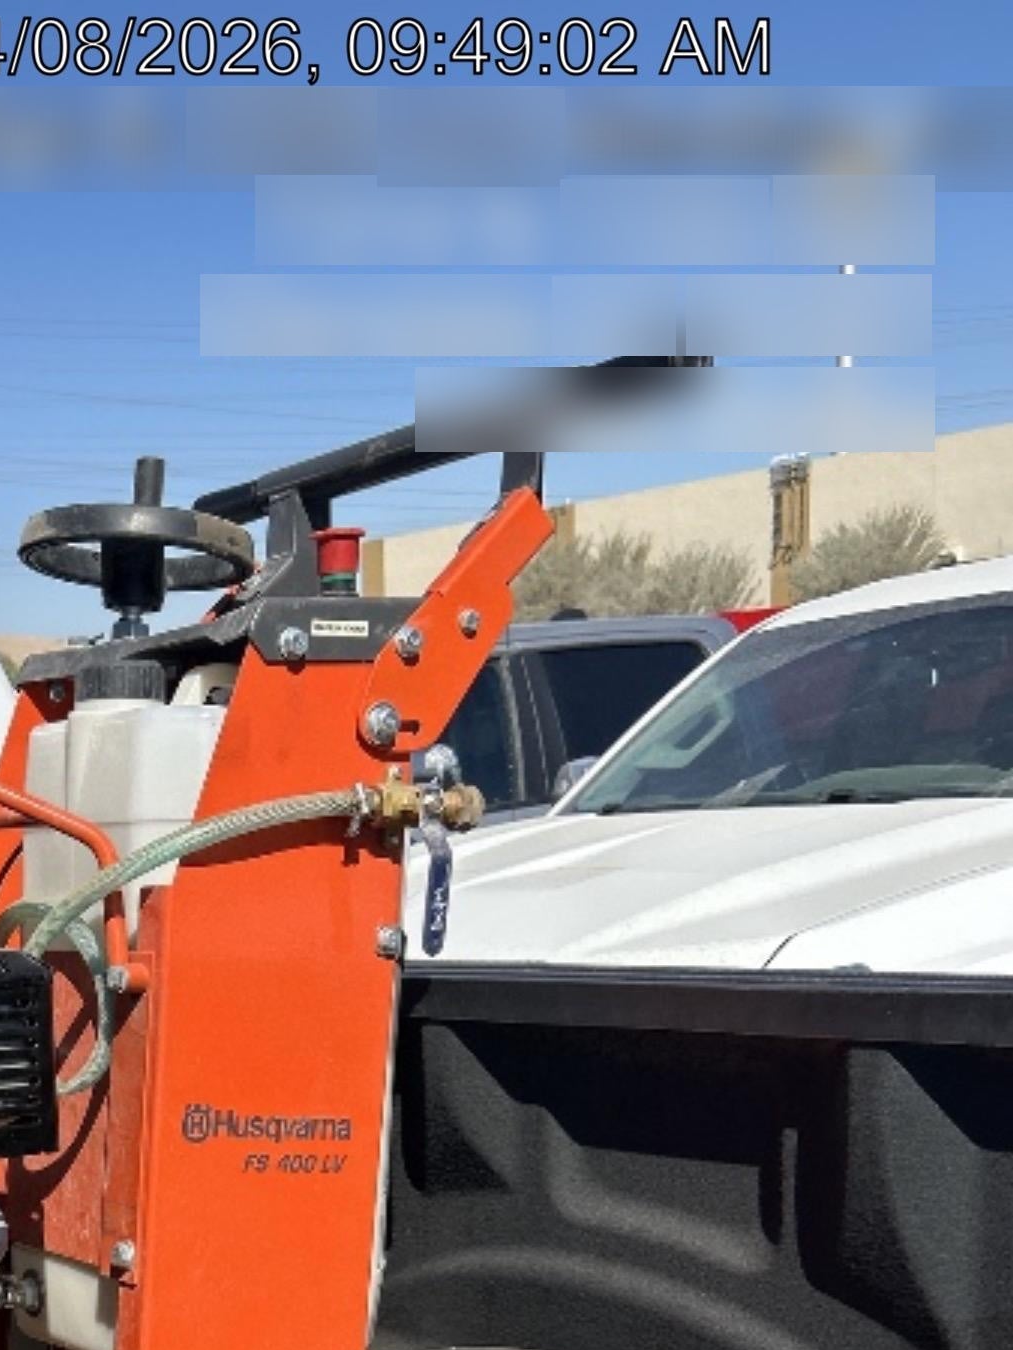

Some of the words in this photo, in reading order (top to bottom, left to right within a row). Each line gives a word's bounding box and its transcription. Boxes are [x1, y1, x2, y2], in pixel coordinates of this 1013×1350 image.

[213, 1109, 351, 1142] Husqvarna
[243, 1154, 269, 1173] FS
[278, 1154, 314, 1173] 400
[320, 1154, 348, 1173] LV
